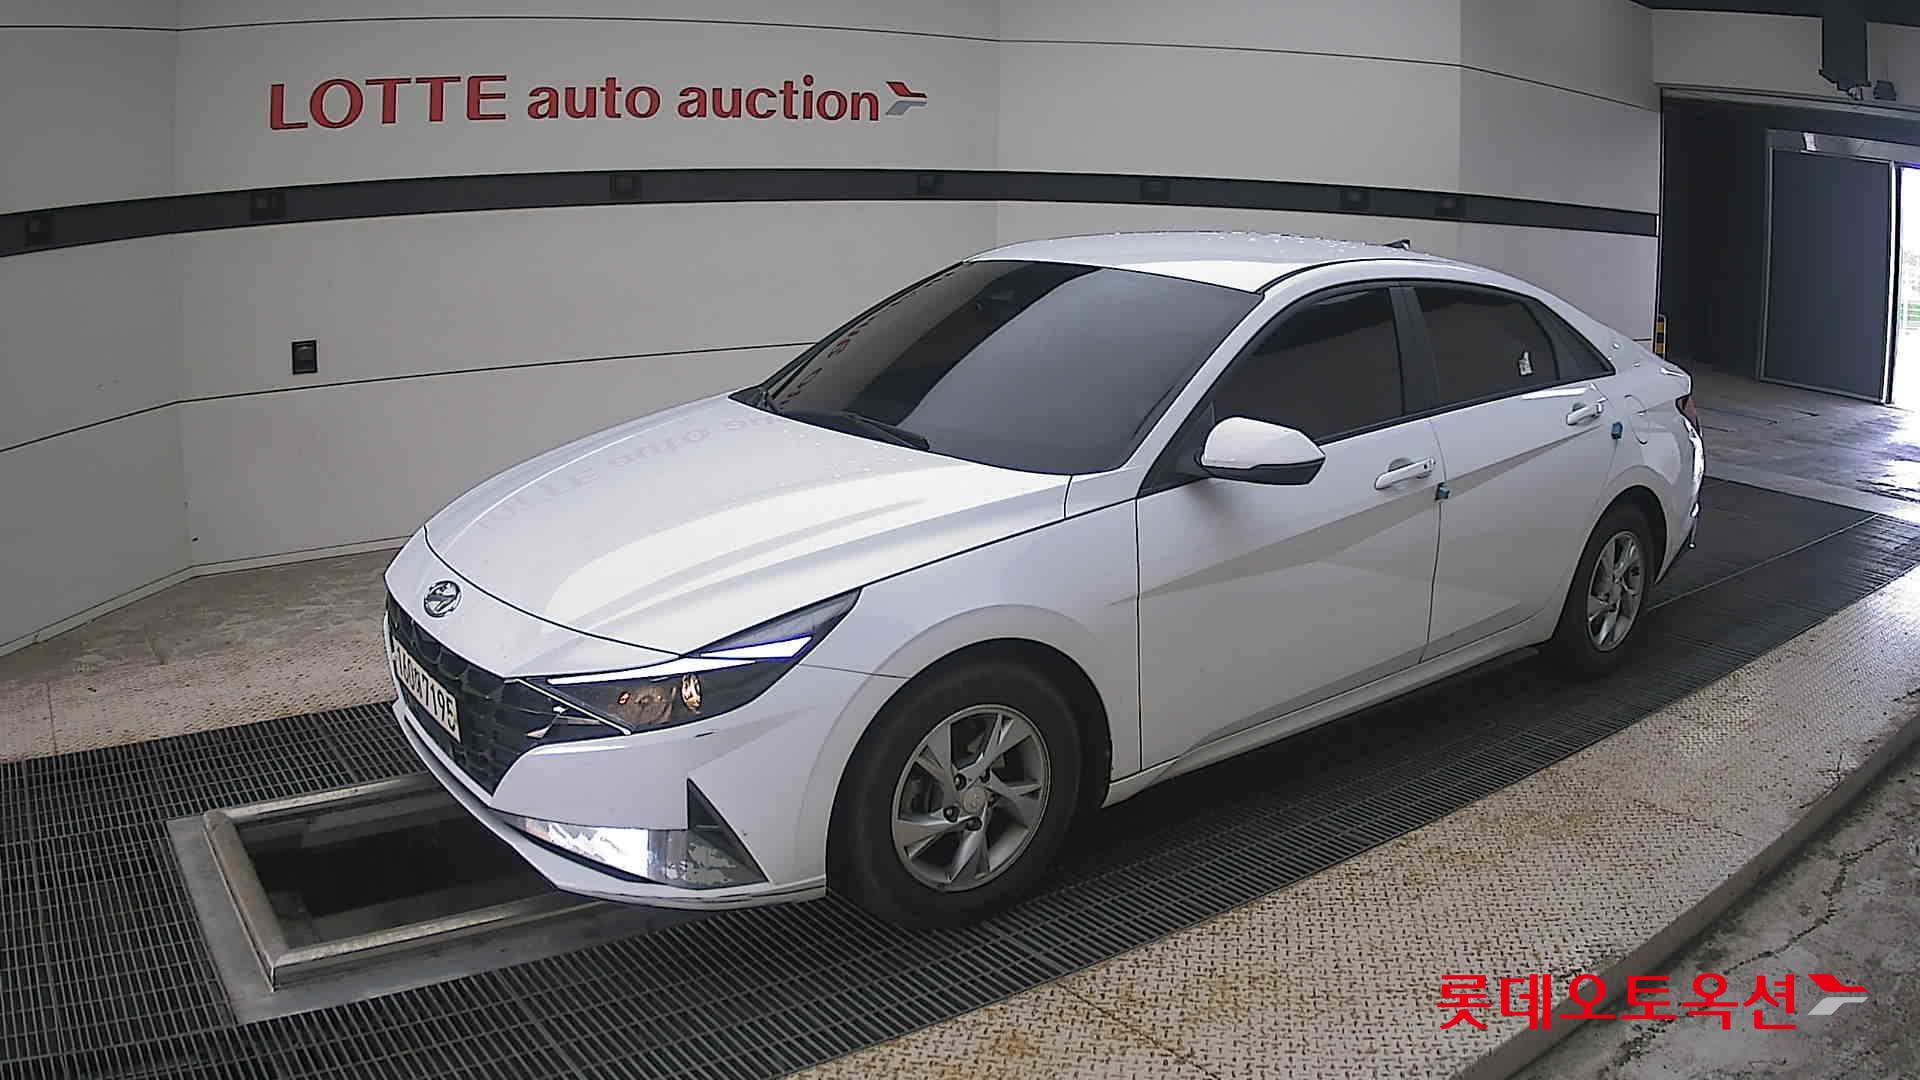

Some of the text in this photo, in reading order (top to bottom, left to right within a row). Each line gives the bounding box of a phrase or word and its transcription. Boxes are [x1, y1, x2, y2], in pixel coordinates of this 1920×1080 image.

[269, 75, 879, 130] LOTTE auto auction
